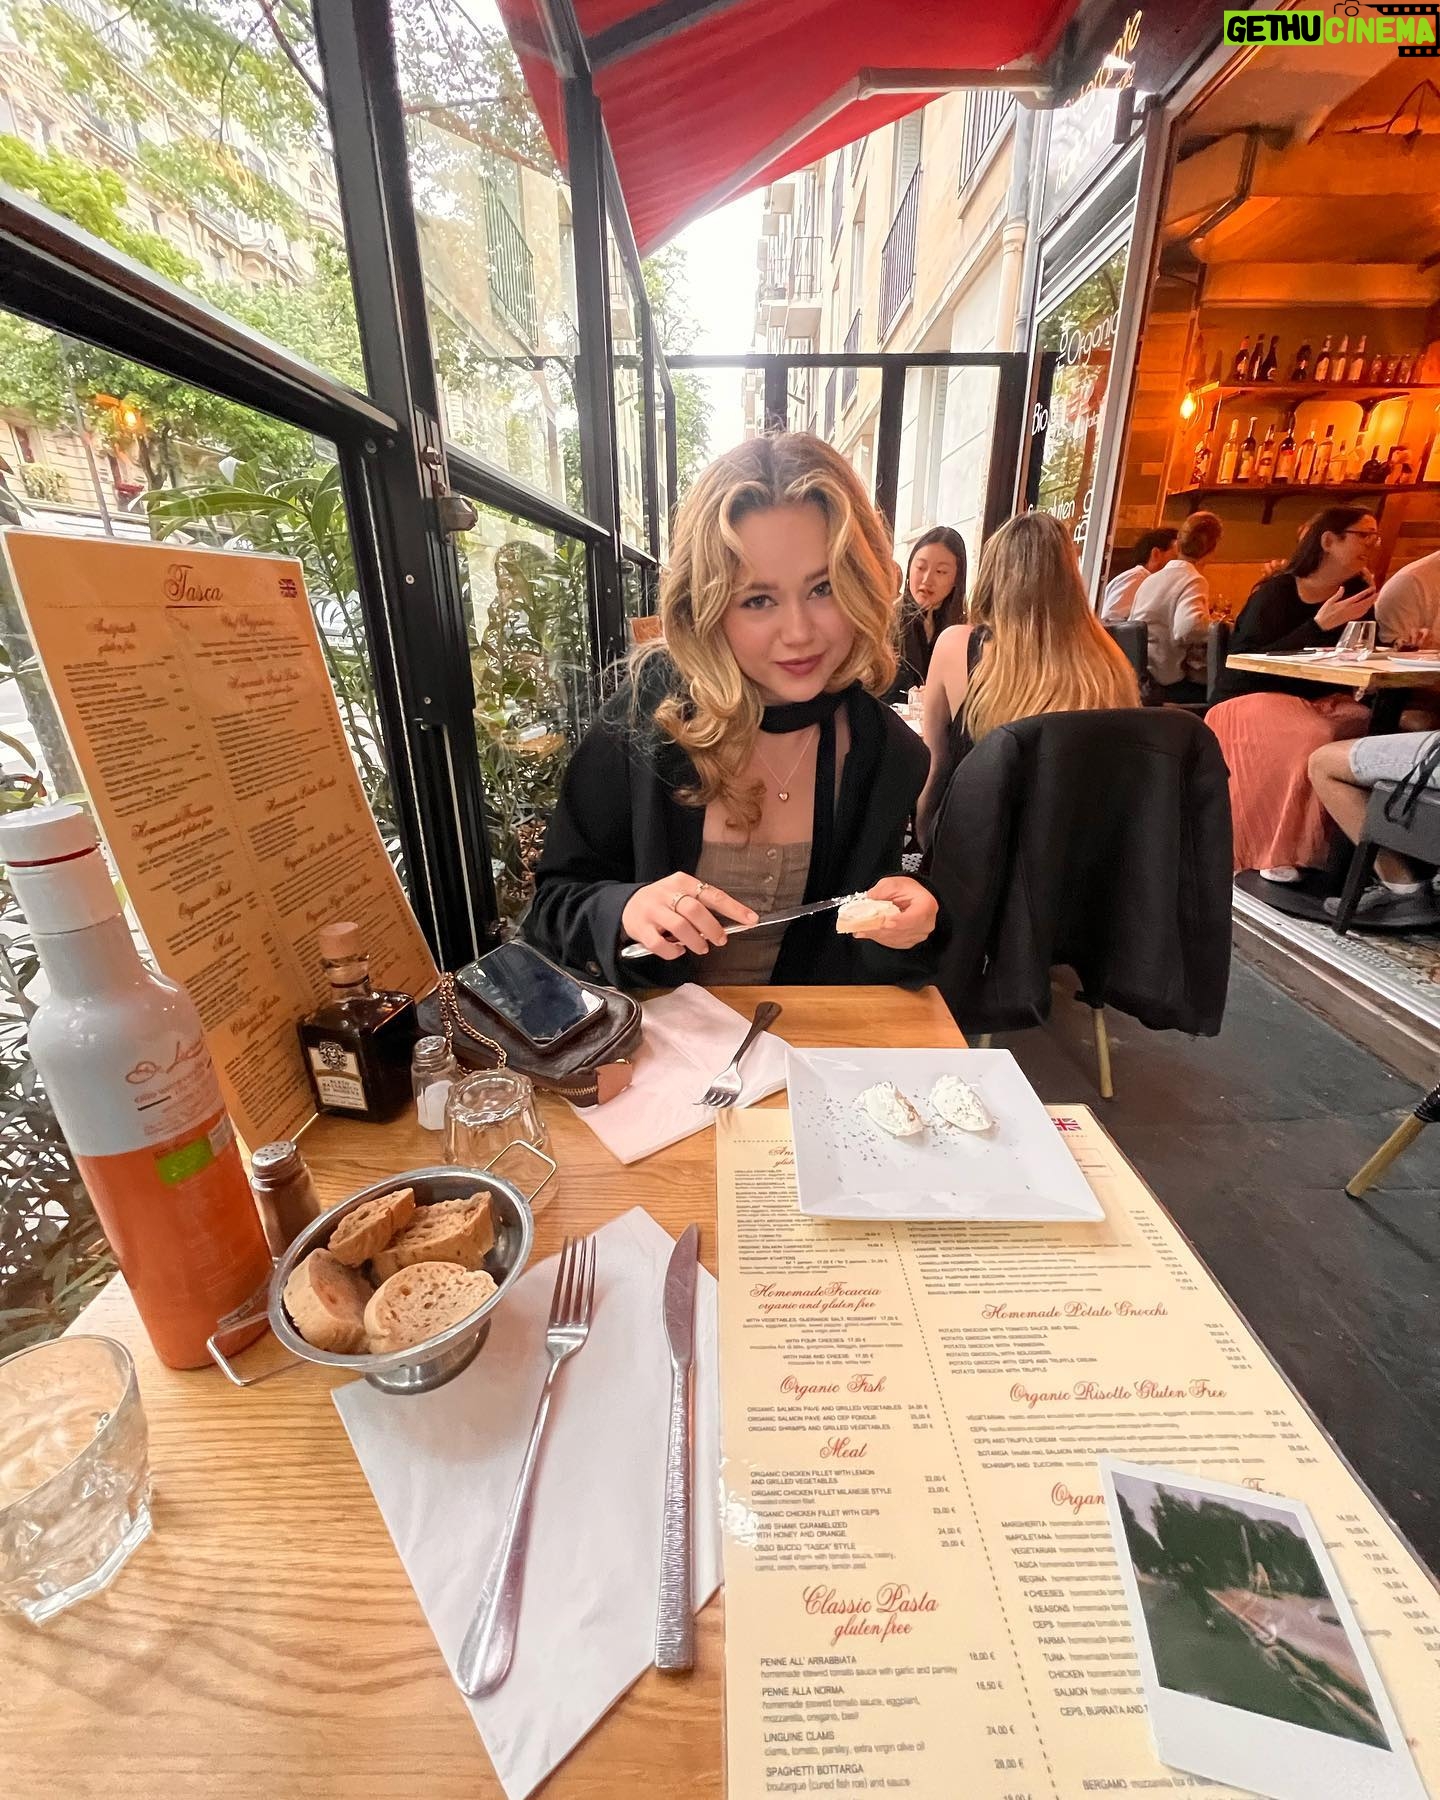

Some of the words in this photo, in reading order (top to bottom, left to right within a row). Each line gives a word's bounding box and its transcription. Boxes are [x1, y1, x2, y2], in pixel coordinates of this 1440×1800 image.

[1032, 402, 1048, 435] Bio
[163, 563, 224, 602] Tasca
[750, 1282, 825, 1298] Homemade
[823, 1281, 882, 1297] Focaccia
[758, 1302, 798, 1314] organic
[798, 1300, 821, 1310] and
[821, 1299, 854, 1313] gluten
[853, 1298, 876, 1312] free
[981, 1302, 1062, 1320] Homemade
[1063, 1300, 1113, 1318] Potato
[1114, 1300, 1168, 1317] Gnocchi
[780, 1374, 841, 1400] Organic
[846, 1373, 888, 1393] Fish
[1009, 1382, 1072, 1409] Organic
[1073, 1380, 1133, 1400] Risotto
[1133, 1379, 1188, 1399] Gluten
[1188, 1378, 1228, 1399] Free
[819, 1436, 868, 1459] Meat
[814, 1488, 835, 1496] FILLET
[871, 1487, 892, 1495] STYLE
[1051, 1481, 1105, 1515] Organ
[753, 1510, 784, 1518] RGANIC
[786, 1510, 816, 1518] CHICKEN
[818, 1509, 840, 1517] FILLET
[861, 1508, 880, 1516] CEPS
[799, 1521, 848, 1529] CARAMELIZED
[1001, 1520, 1048, 1528] MARGHERITA
[773, 1531, 797, 1539] HONEY
[800, 1530, 815, 1538] AND
[1005, 1533, 1052, 1541] NAPOLETANA
[833, 1542, 856, 1550] STYLE
[1011, 1547, 1057, 1555] VEGETARIAN
[1014, 1561, 1038, 1569] TASCA
[1018, 1575, 1047, 1583] REGINA
[802, 1584, 872, 1615] Classic
[876, 1582, 939, 1613] Pasta
[1029, 1589, 1064, 1598] CHEESES
[1034, 1604, 1070, 1613] SEASONS
[830, 1615, 883, 1647] gluten
[880, 1612, 912, 1643] free
[1039, 1636, 1066, 1645] PARMA
[760, 1657, 787, 1667] PENNE
[808, 1655, 856, 1665] ARRABBIATA
[1044, 1652, 1065, 1662] TUNA
[917, 1666, 930, 1674] and
[1048, 1669, 1084, 1679] CHICKEN
[762, 1687, 789, 1697] PENNE
[792, 1686, 811, 1696] ALLA
[814, 1685, 844, 1695] NORMA
[1054, 1687, 1088, 1697] SALMON
[1060, 1706, 1083, 1717] CEPS,
[1086, 1705, 1125, 1716] BURRATA
[1126, 1704, 1144, 1714] AND
[764, 1732, 804, 1743] LINGUINE
[806, 1730, 835, 1741] CLAMS
[766, 1765, 814, 1777] SPAGHETTI
[817, 1763, 864, 1775] BOTTARGA
[870, 1778, 885, 1788] and
[1083, 1777, 1128, 1792] BERGAMO
